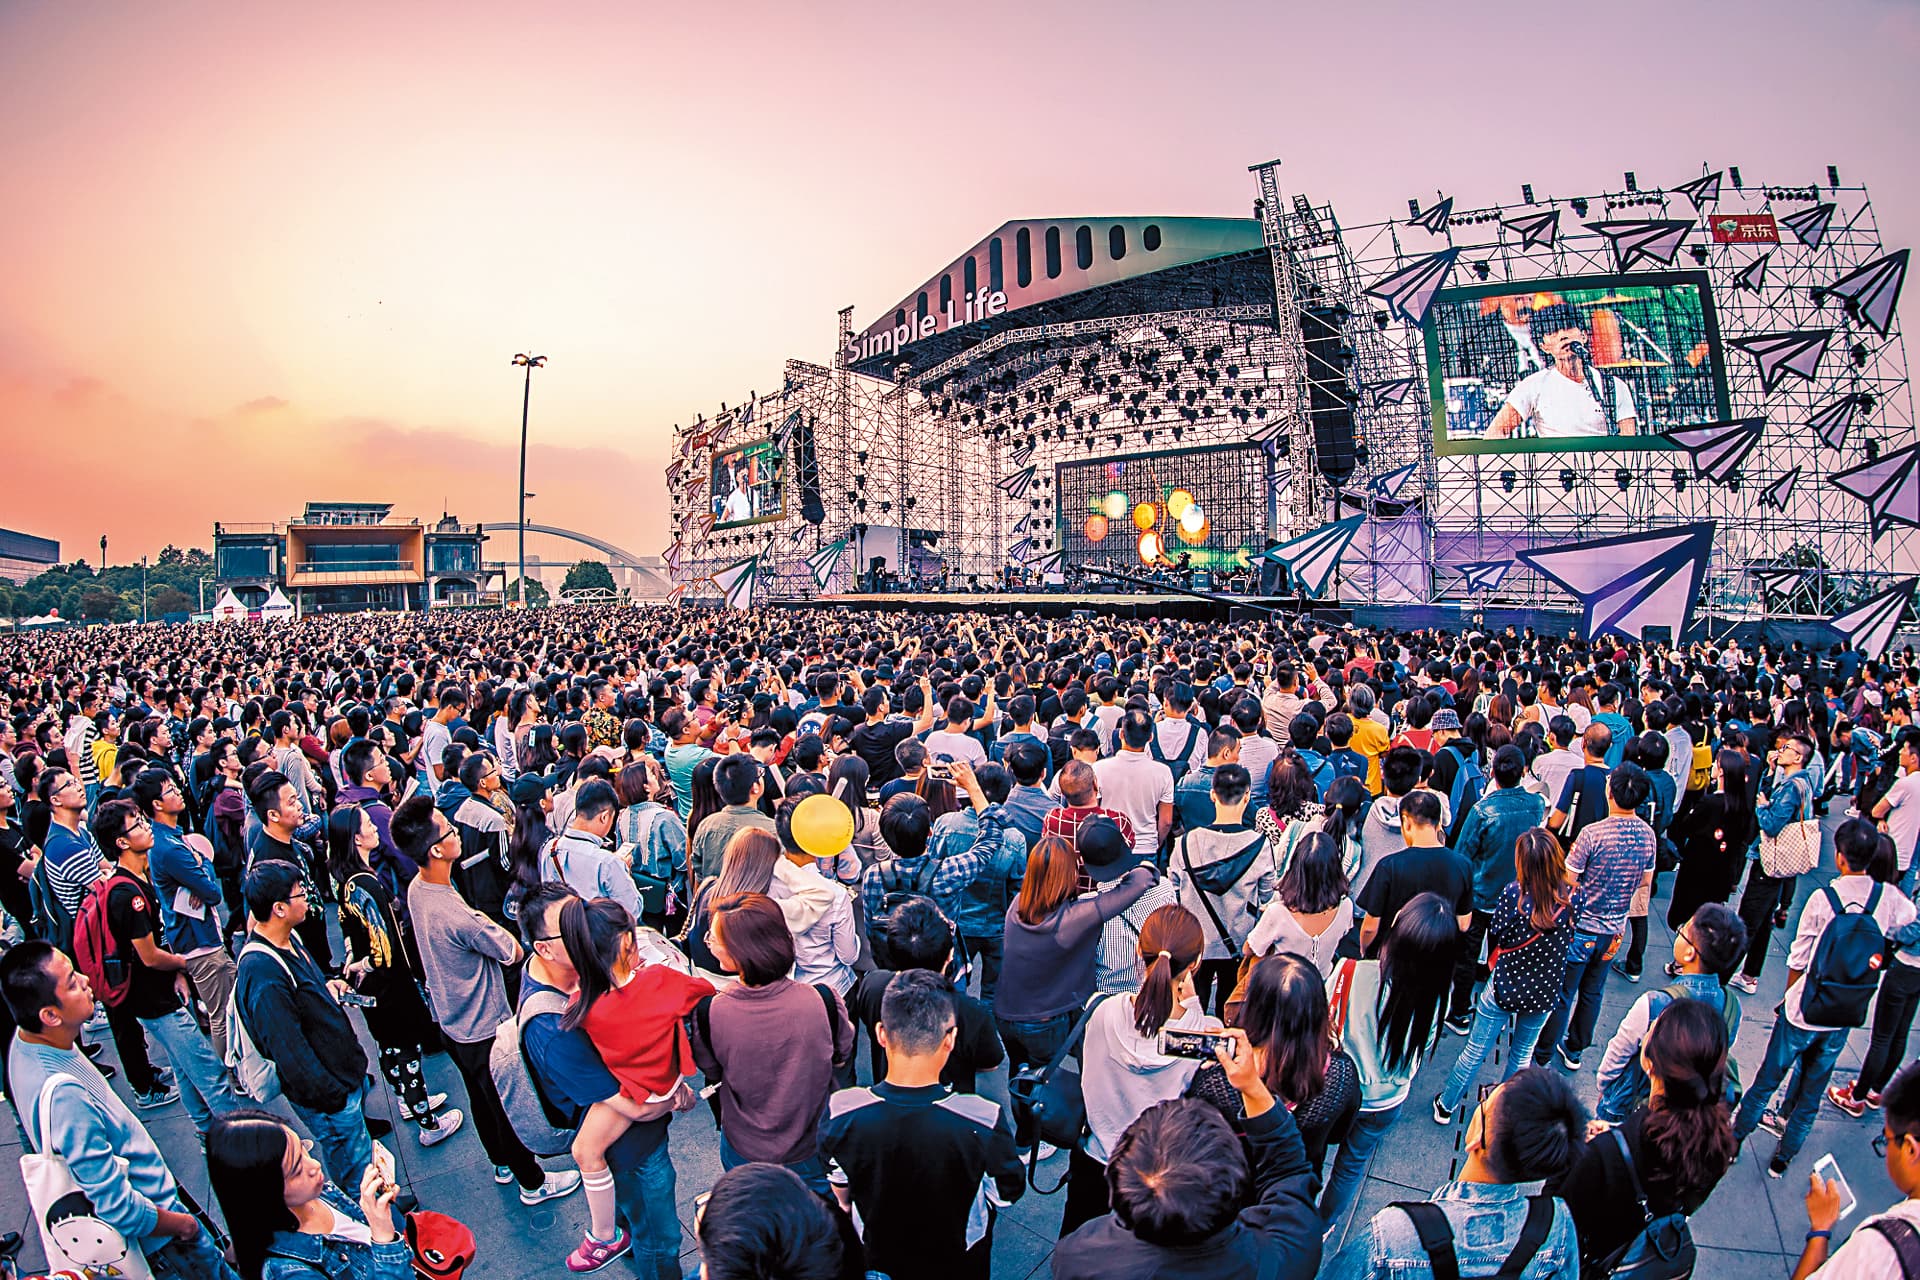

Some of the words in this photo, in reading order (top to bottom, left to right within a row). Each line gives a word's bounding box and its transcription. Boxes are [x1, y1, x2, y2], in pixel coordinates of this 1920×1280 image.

[1740, 224, 1774, 238] 京东
[848, 310, 936, 364] Simple
[947, 286, 1007, 329] Life
